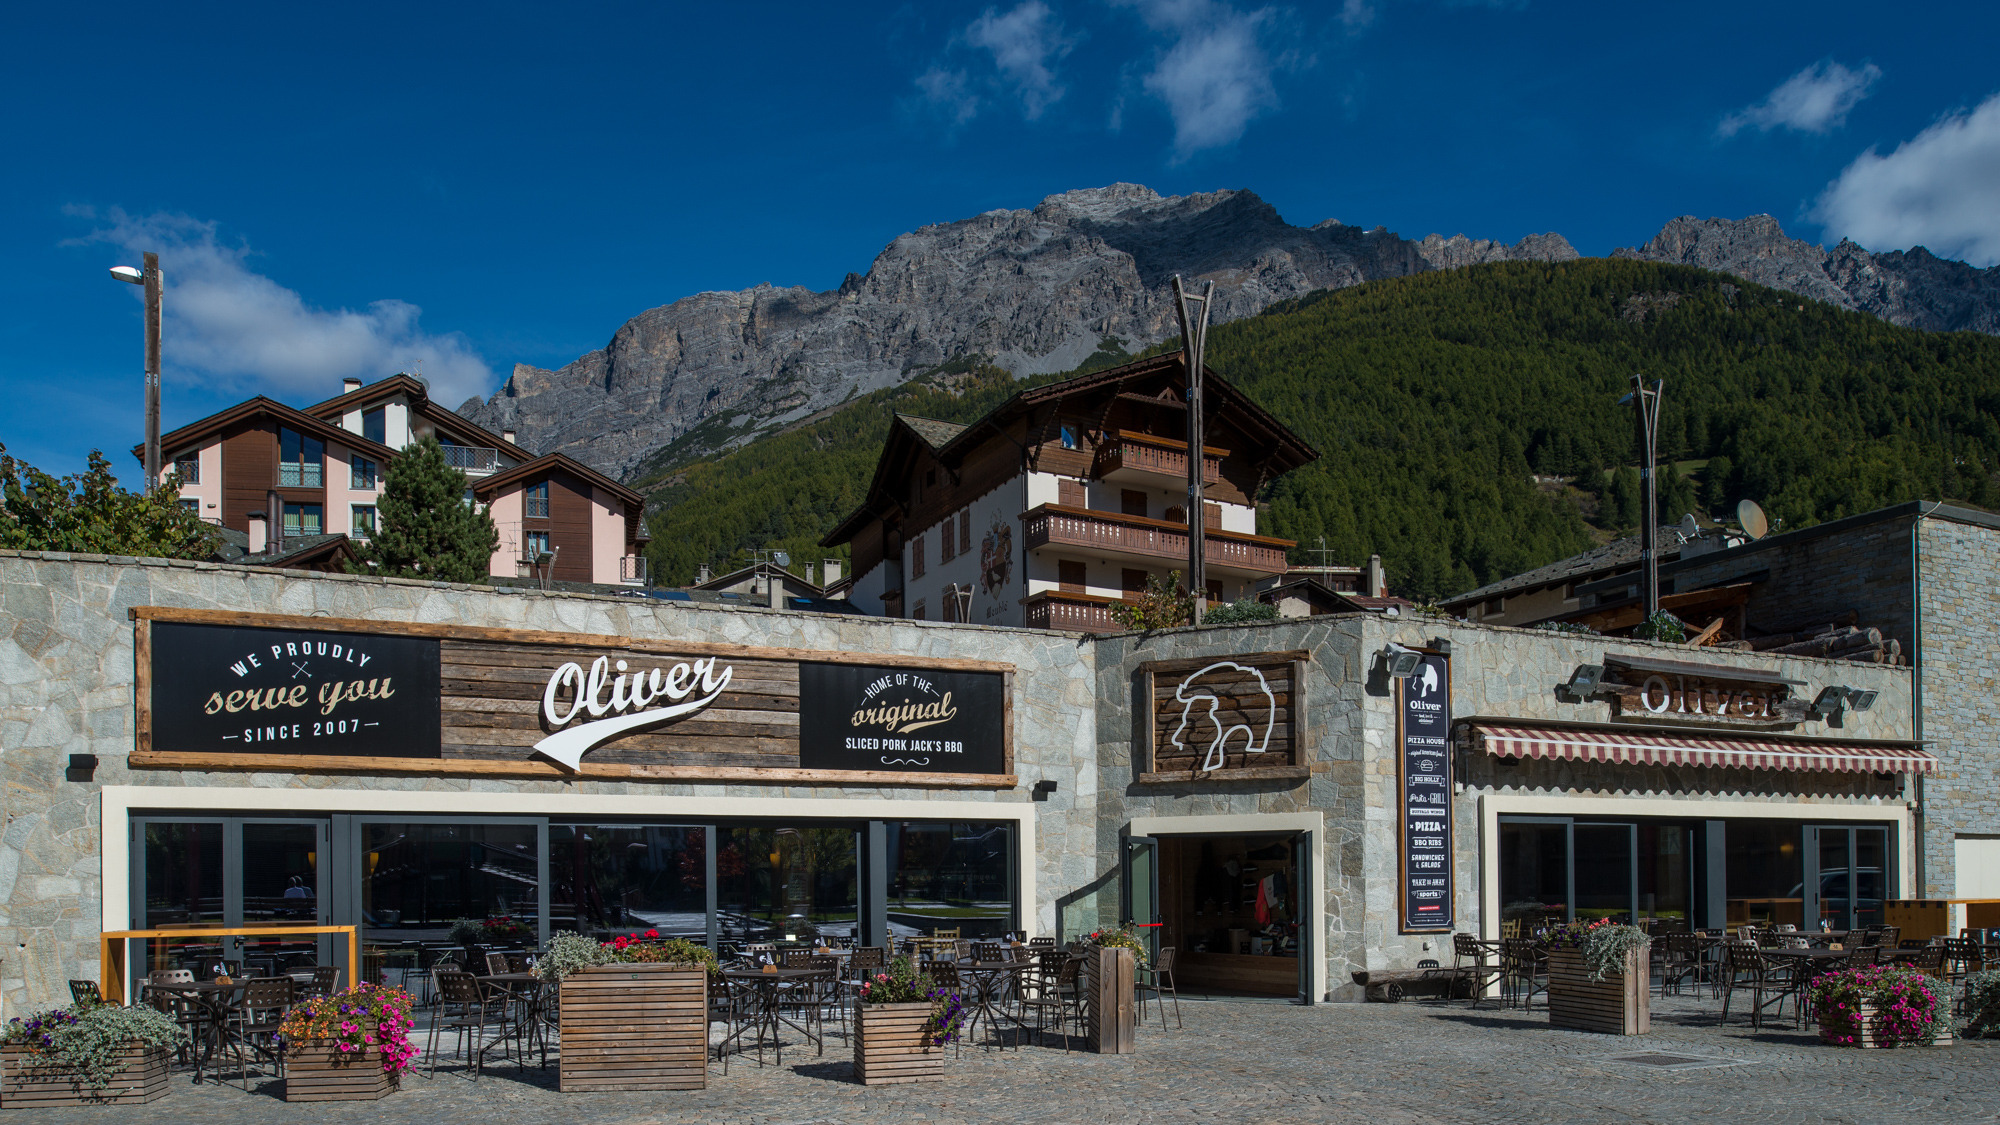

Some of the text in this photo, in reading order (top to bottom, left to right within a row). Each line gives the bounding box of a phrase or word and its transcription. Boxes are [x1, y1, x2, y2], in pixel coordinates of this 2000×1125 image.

[229, 641, 372, 679] WE PROUDLY
[204, 676, 396, 715] serve you
[542, 655, 733, 726] Oliver
[864, 674, 932, 698] HOME OF THE
[1641, 675, 1778, 717] Oliver
[851, 691, 957, 733] original
[1410, 700, 1442, 711] Oliver
[244, 719, 360, 744] SINCE 2007
[846, 738, 963, 754] SLICED PORK JACK'S BBQ
[1430, 793, 1446, 804] GRILL
[1415, 821, 1441, 832] PIZZA
[1432, 878, 1445, 886] AWAY
